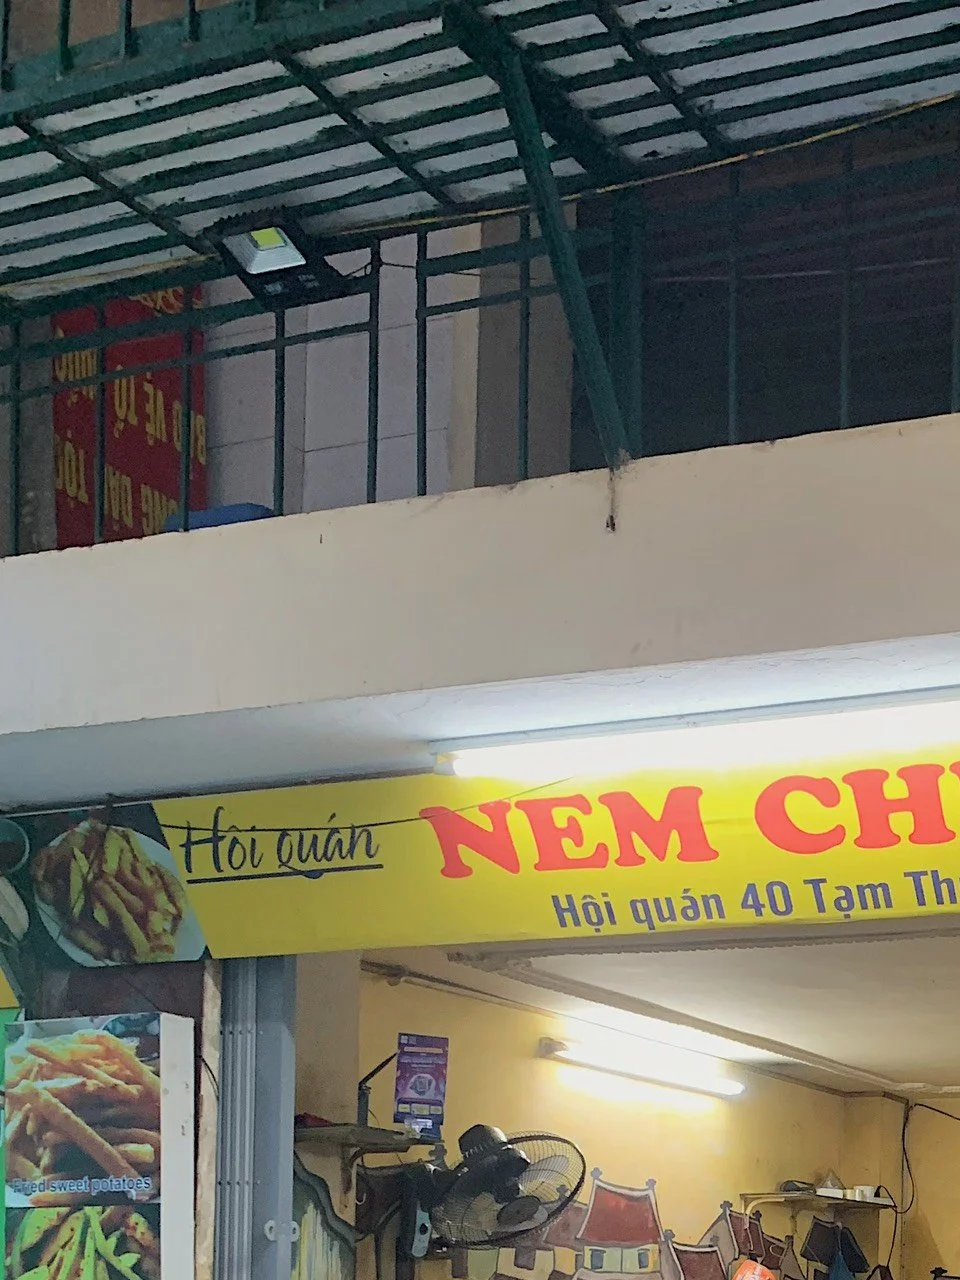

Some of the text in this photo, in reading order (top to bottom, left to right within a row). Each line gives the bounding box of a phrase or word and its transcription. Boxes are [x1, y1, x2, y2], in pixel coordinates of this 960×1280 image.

[419, 784, 720, 879] NEM
[551, 893, 617, 934] Hội
[630, 885, 726, 932] quán
[741, 880, 794, 918] 40
[803, 874, 893, 921] Tạm
[48, 1175, 90, 1193] sweet
[91, 1174, 152, 1196] potatoes
